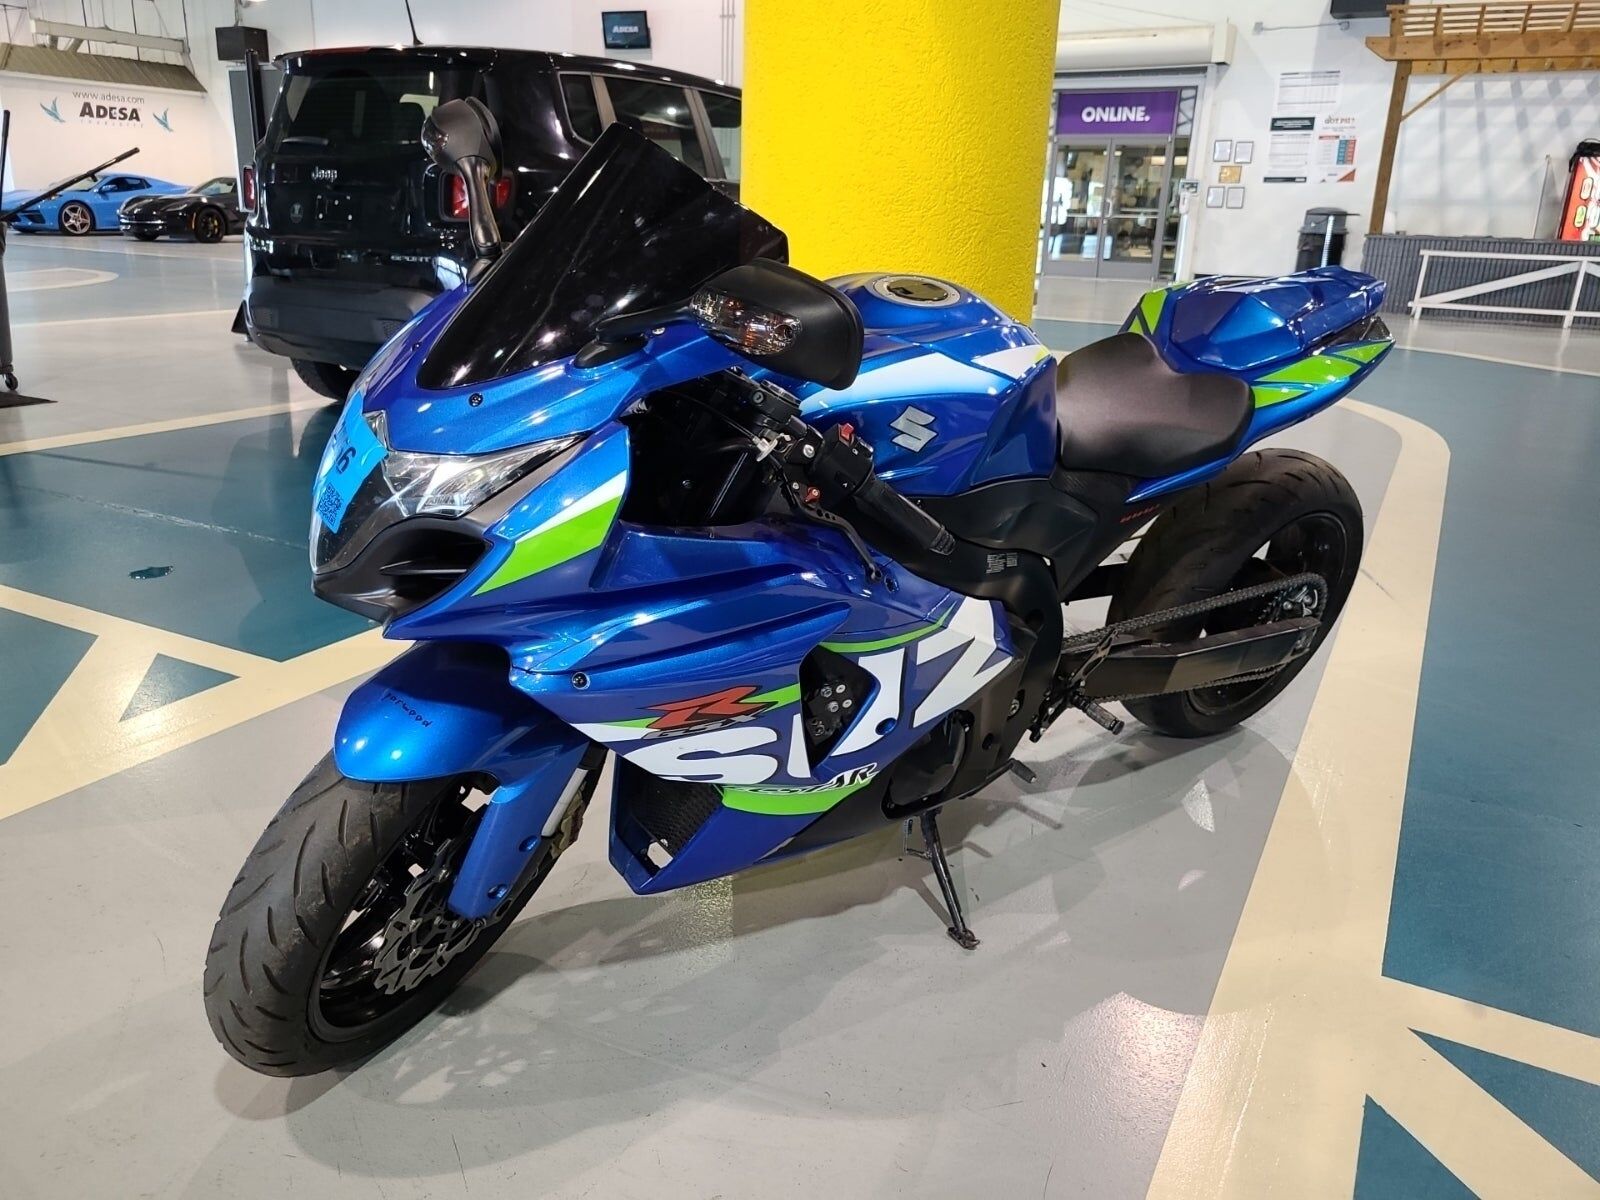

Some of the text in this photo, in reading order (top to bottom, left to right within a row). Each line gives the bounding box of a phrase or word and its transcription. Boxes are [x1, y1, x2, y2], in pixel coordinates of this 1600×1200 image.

[72, 91, 145, 105] www.adesa.com
[79, 101, 141, 122] ADESA
[1081, 106, 1151, 123] ONLINE.
